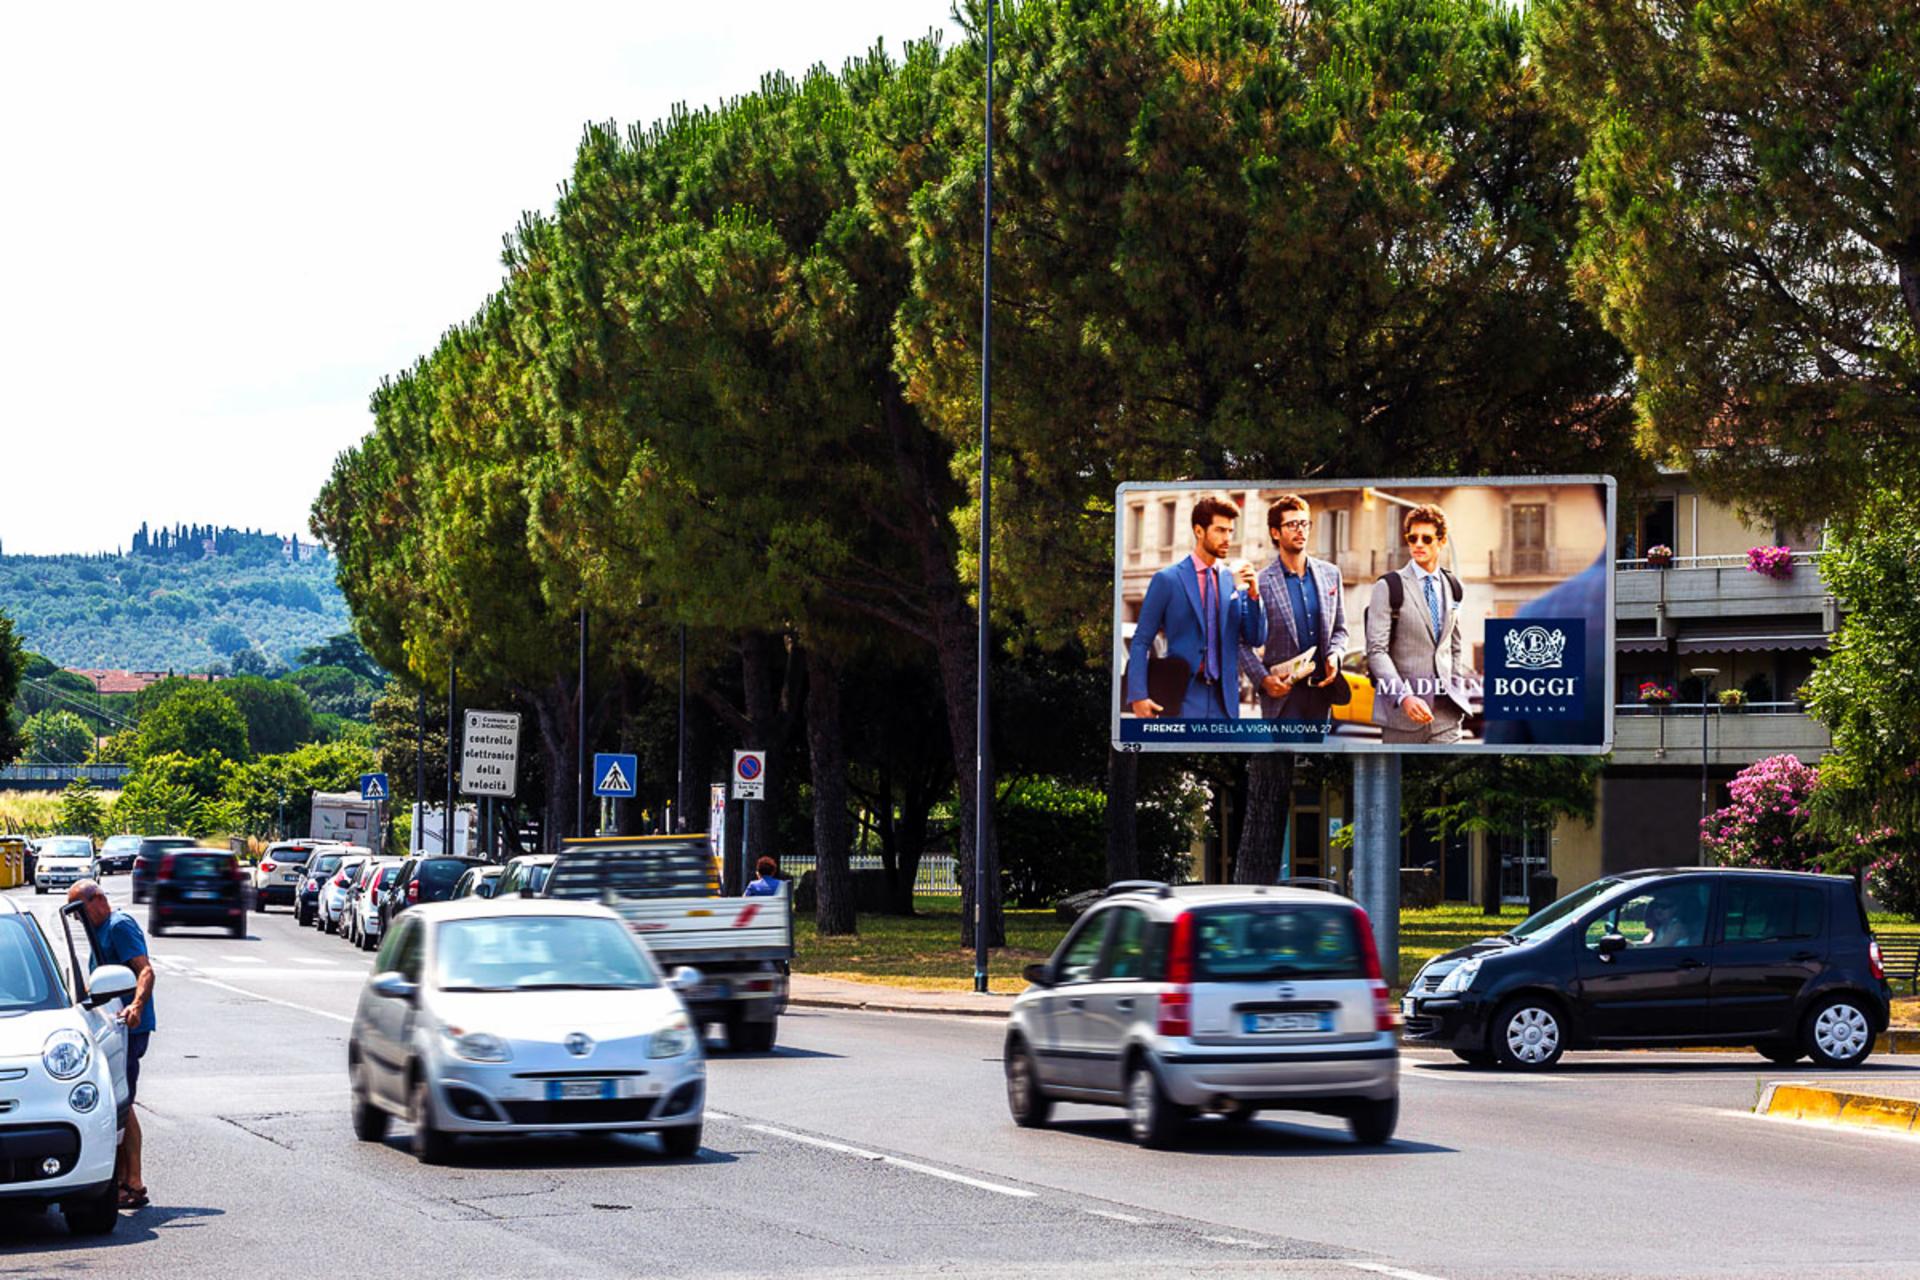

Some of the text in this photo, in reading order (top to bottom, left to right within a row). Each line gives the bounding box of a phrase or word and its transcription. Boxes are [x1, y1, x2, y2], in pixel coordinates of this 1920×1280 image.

[1376, 677, 1447, 696] MADE
[1494, 677, 1576, 696] BOGGI
[1502, 705, 1567, 713] MILANO
[1142, 723, 1333, 734] FIRENZE VIA DELLA VIGNA NUOVA 27
[469, 735, 513, 745] controllo
[1122, 743, 1143, 752] 29
[465, 749, 515, 760] elettronico
[476, 764, 501, 775] della
[469, 780, 507, 790] velocità
